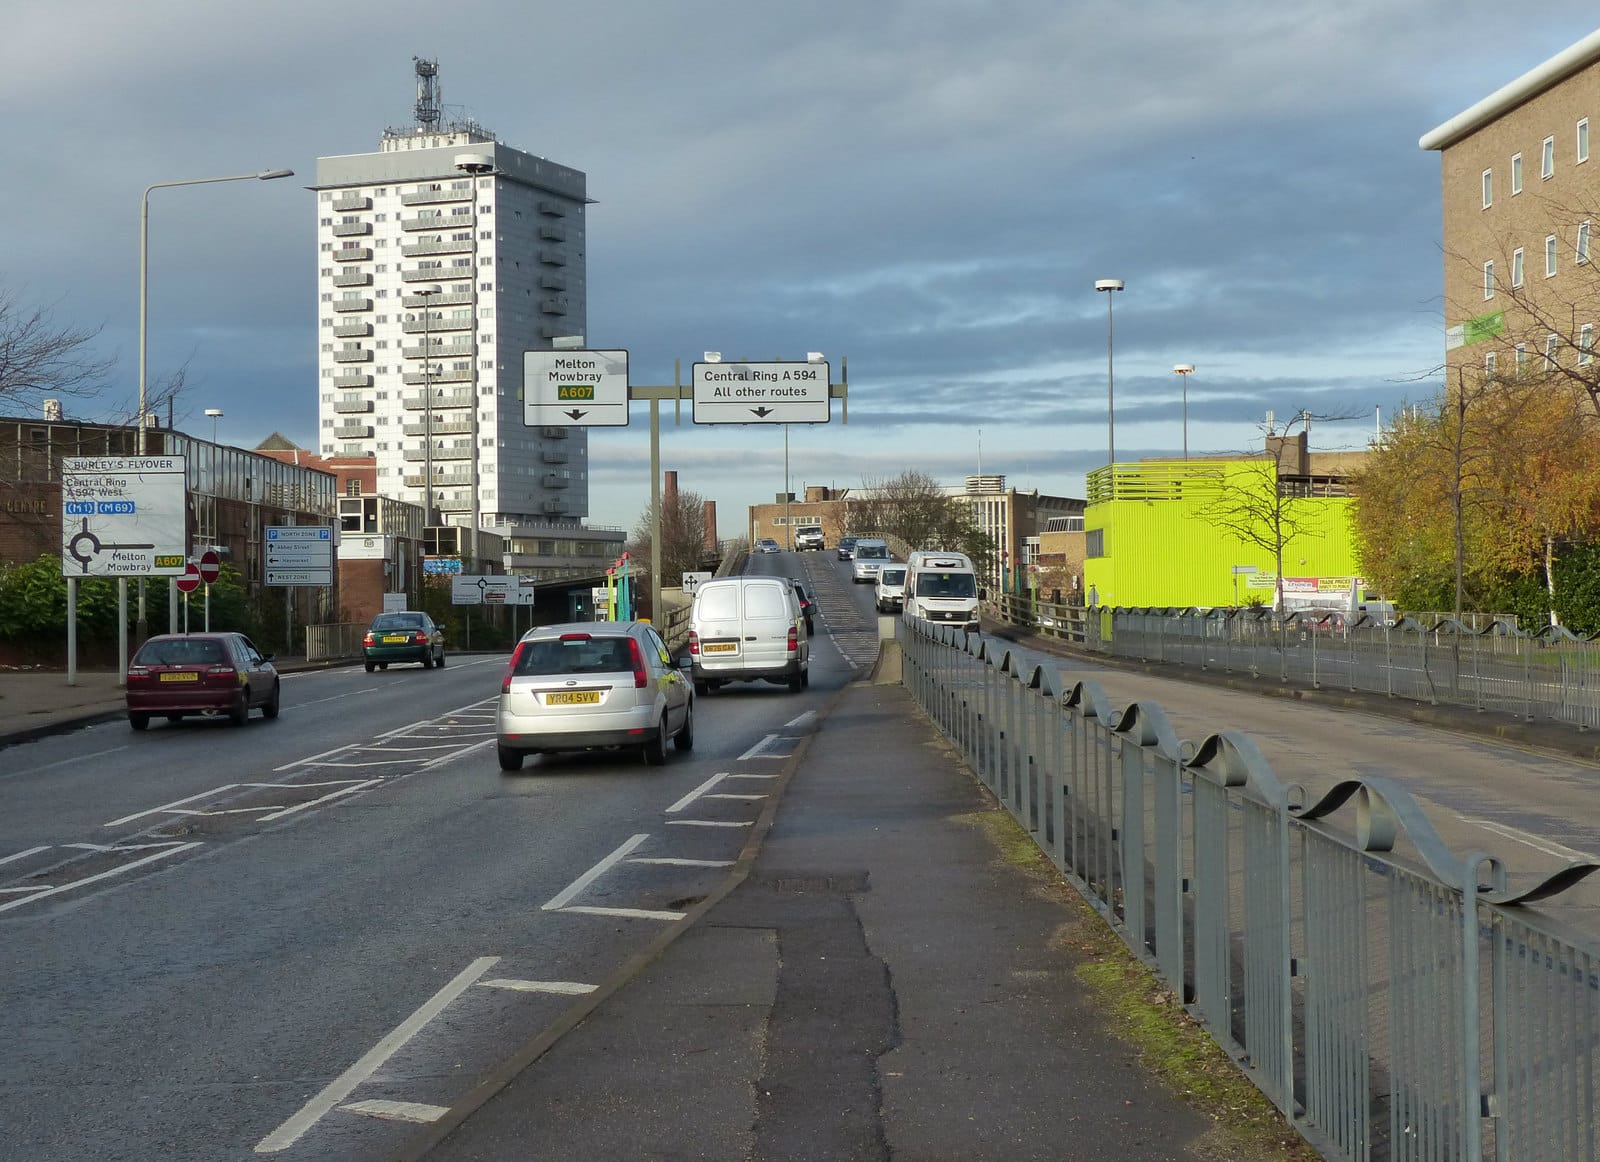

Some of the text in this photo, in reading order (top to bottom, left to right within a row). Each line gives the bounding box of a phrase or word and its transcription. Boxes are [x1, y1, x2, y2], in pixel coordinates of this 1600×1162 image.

[555, 359, 596, 369] Melton
[549, 371, 602, 383] Mowbray
[704, 371, 749, 381] Central
[752, 371, 778, 382] Ring
[560, 387, 593, 397] A607
[714, 387, 807, 397] All other routes
[74, 460, 173, 470] BURLEY'S FLYOVER
[66, 478, 127, 487] Central Ring
[99, 488, 123, 496] West
[112, 553, 146, 561] Melton
[156, 557, 183, 566] A607
[107, 563, 151, 572] Mowbray
[549, 694, 574, 704] YR04
